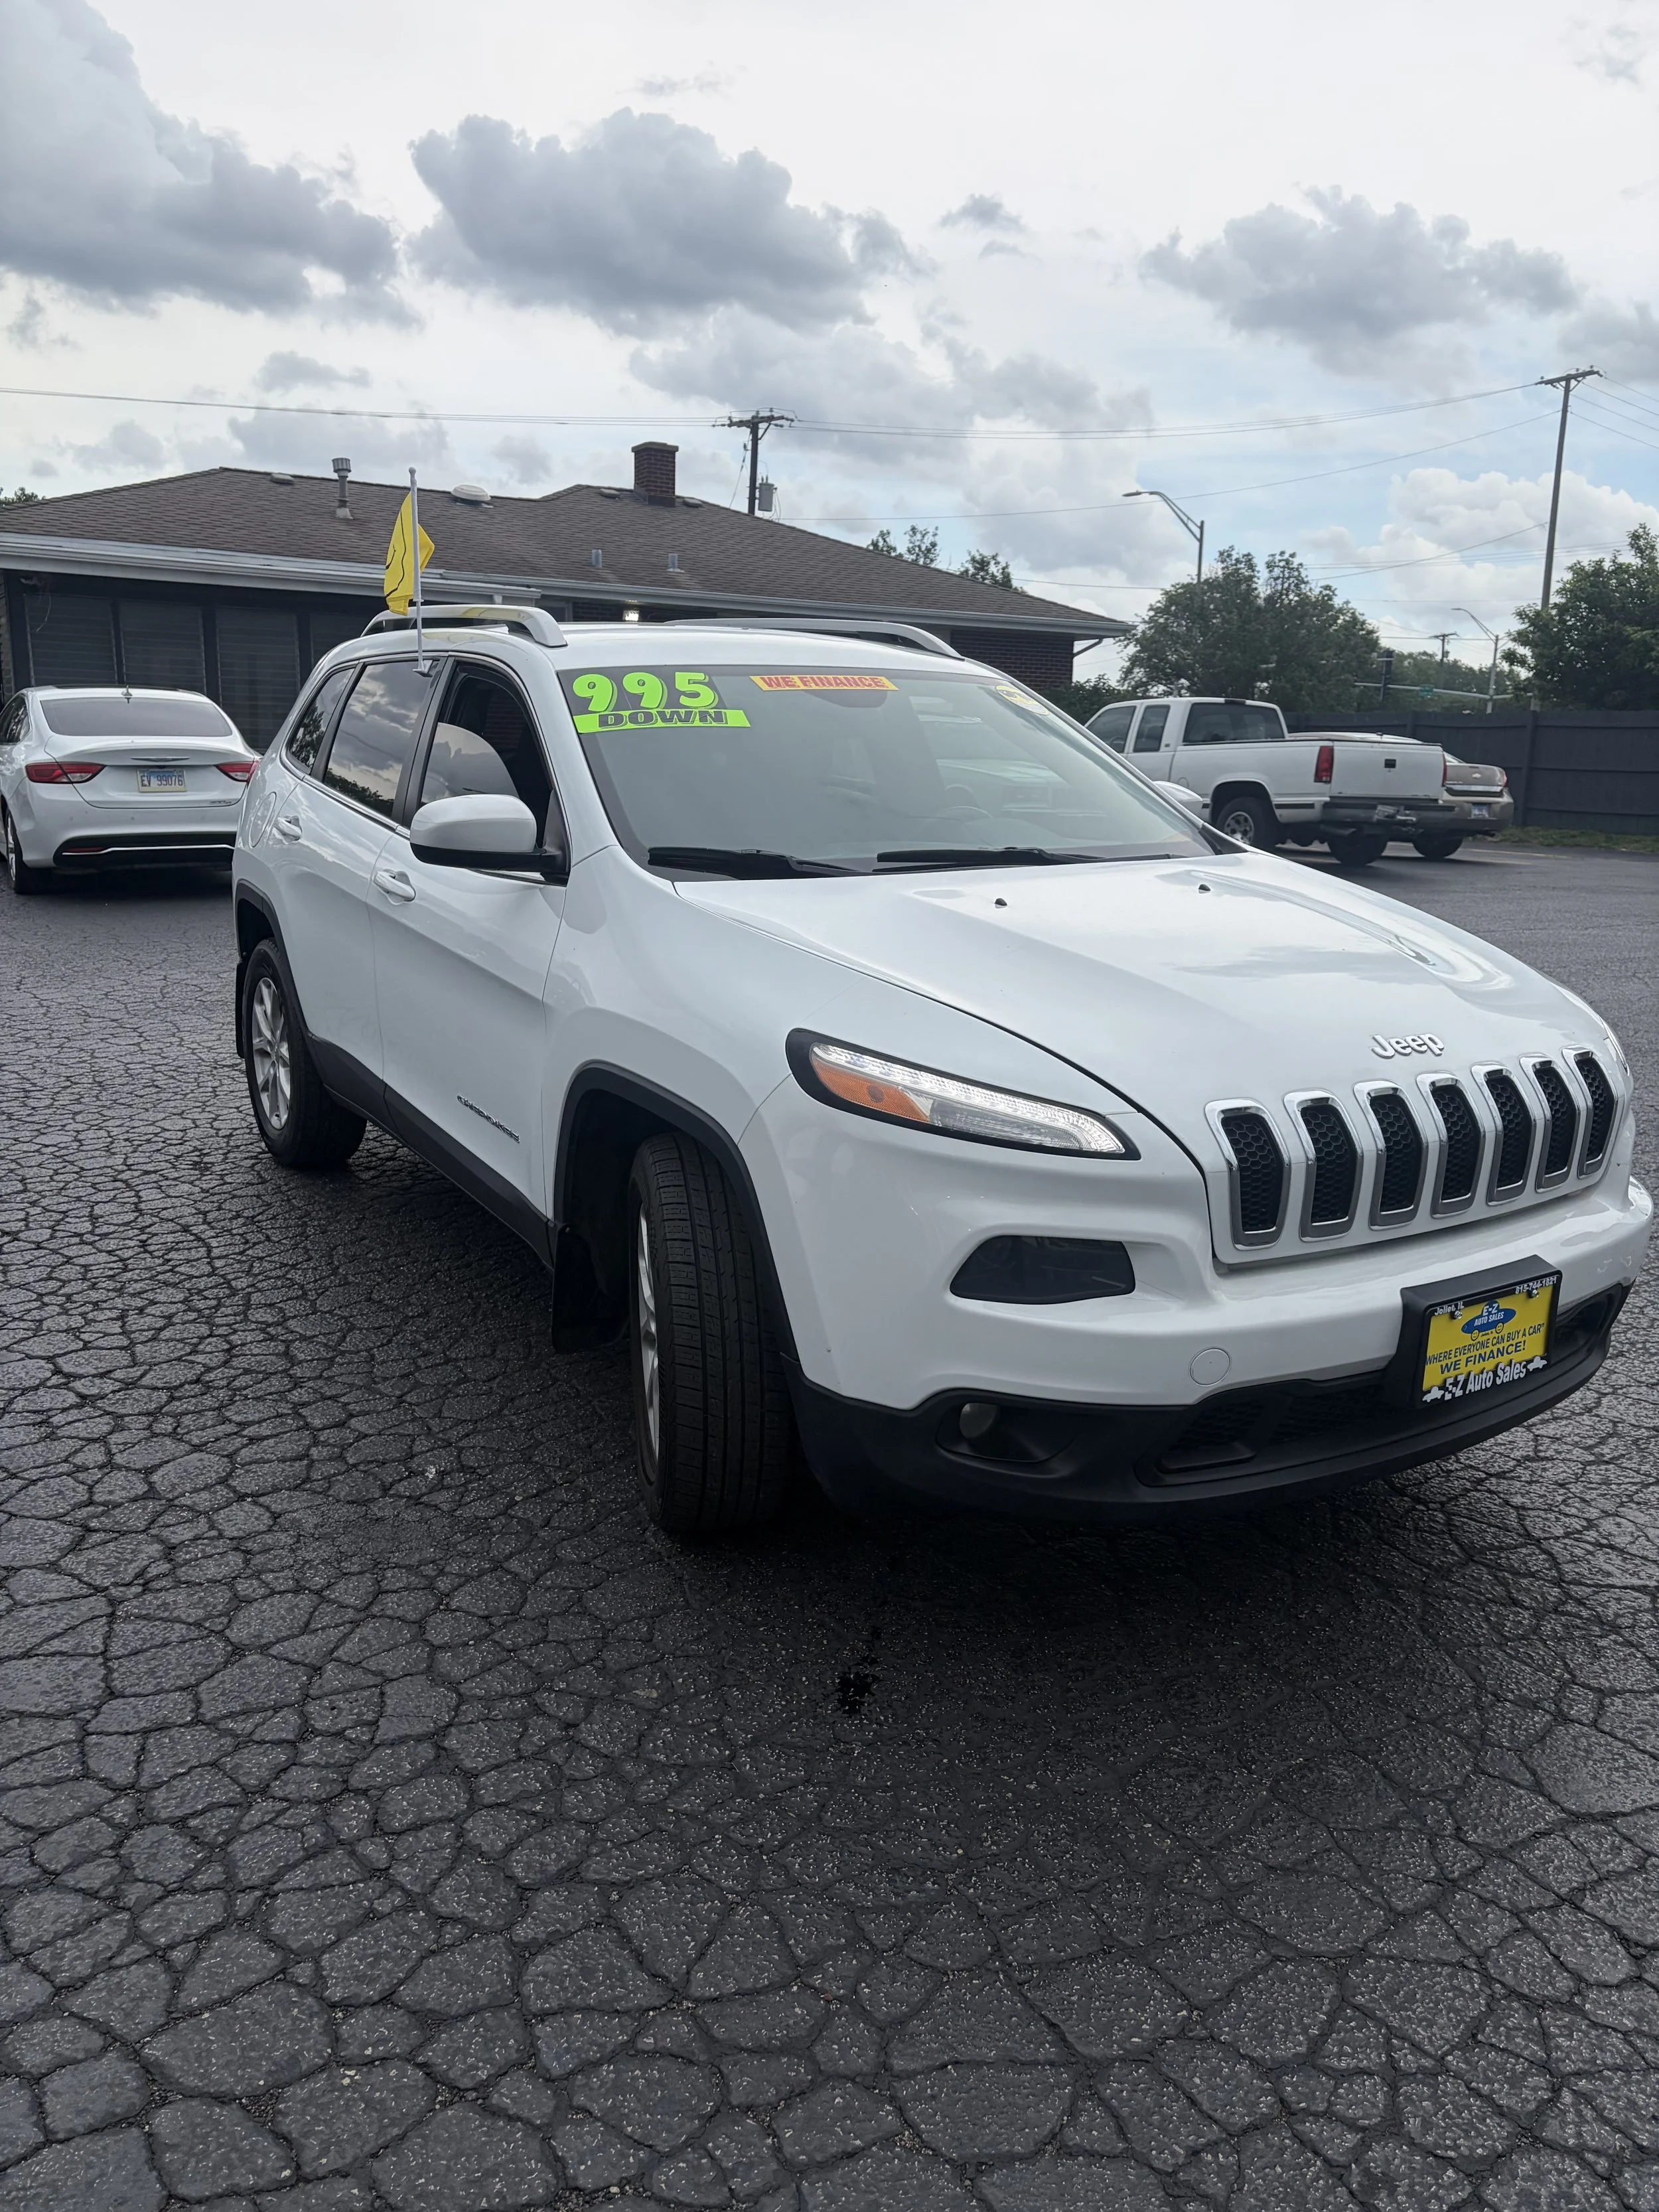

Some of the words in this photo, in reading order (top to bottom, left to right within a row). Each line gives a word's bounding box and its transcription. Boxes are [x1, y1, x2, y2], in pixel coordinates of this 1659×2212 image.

[760, 676, 797, 688] WE
[798, 677, 886, 688] FINANCE
[572, 672, 719, 713] 995
[598, 710, 729, 729] DOWN
[157, 774, 183, 786] 99076
[1370, 1033, 1445, 1059] Jeep
[1516, 1276, 1557, 1294] 815-744-1821
[1457, 1301, 1465, 1310] IL
[1482, 1303, 1499, 1316] E-Z
[1474, 1316, 1488, 1327] AUTO
[1488, 1311, 1504, 1323] SALES
[1425, 1349, 1453, 1366] WHERE
[1454, 1337, 1490, 1359] EVERYONE
[1491, 1334, 1505, 1347] CAN
[1506, 1329, 1521, 1343] BUY
[1522, 1328, 1527, 1338] A
[1440, 1359, 1461, 1375] WE
[1465, 1340, 1526, 1368] FINANCE!
[1465, 1369, 1493, 1394] Auto
[1496, 1359, 1527, 1385] Sales
